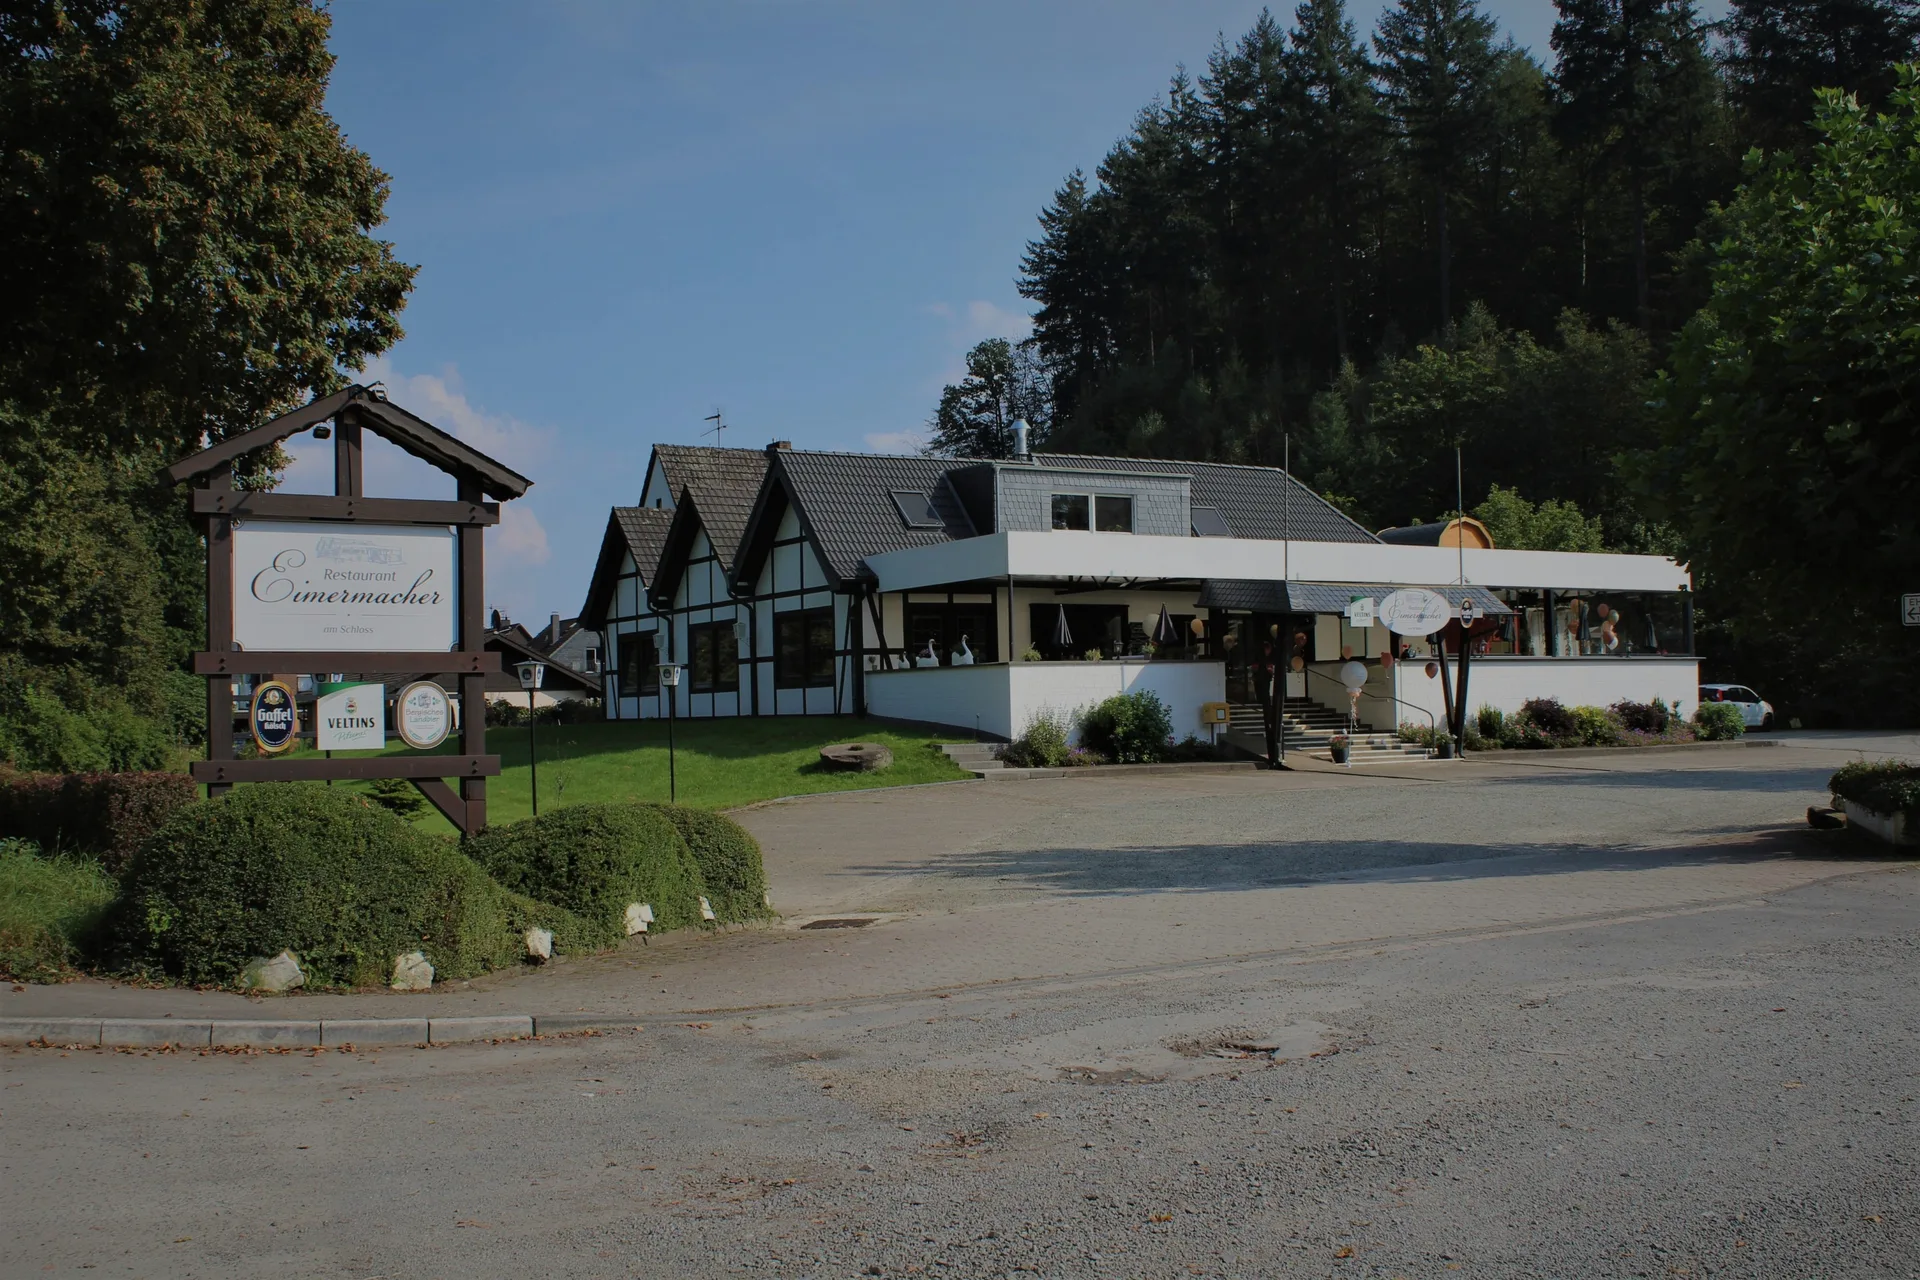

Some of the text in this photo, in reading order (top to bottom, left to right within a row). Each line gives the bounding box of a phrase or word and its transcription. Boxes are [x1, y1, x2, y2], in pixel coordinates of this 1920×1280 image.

[251, 549, 444, 605] Eimermacher
[323, 568, 397, 582] Restaurant
[323, 624, 374, 634] am Schloss
[257, 707, 293, 722] Gaffel
[405, 708, 444, 717] Bergisches
[328, 717, 376, 729] VELTINS
[409, 715, 441, 723] Landbier
